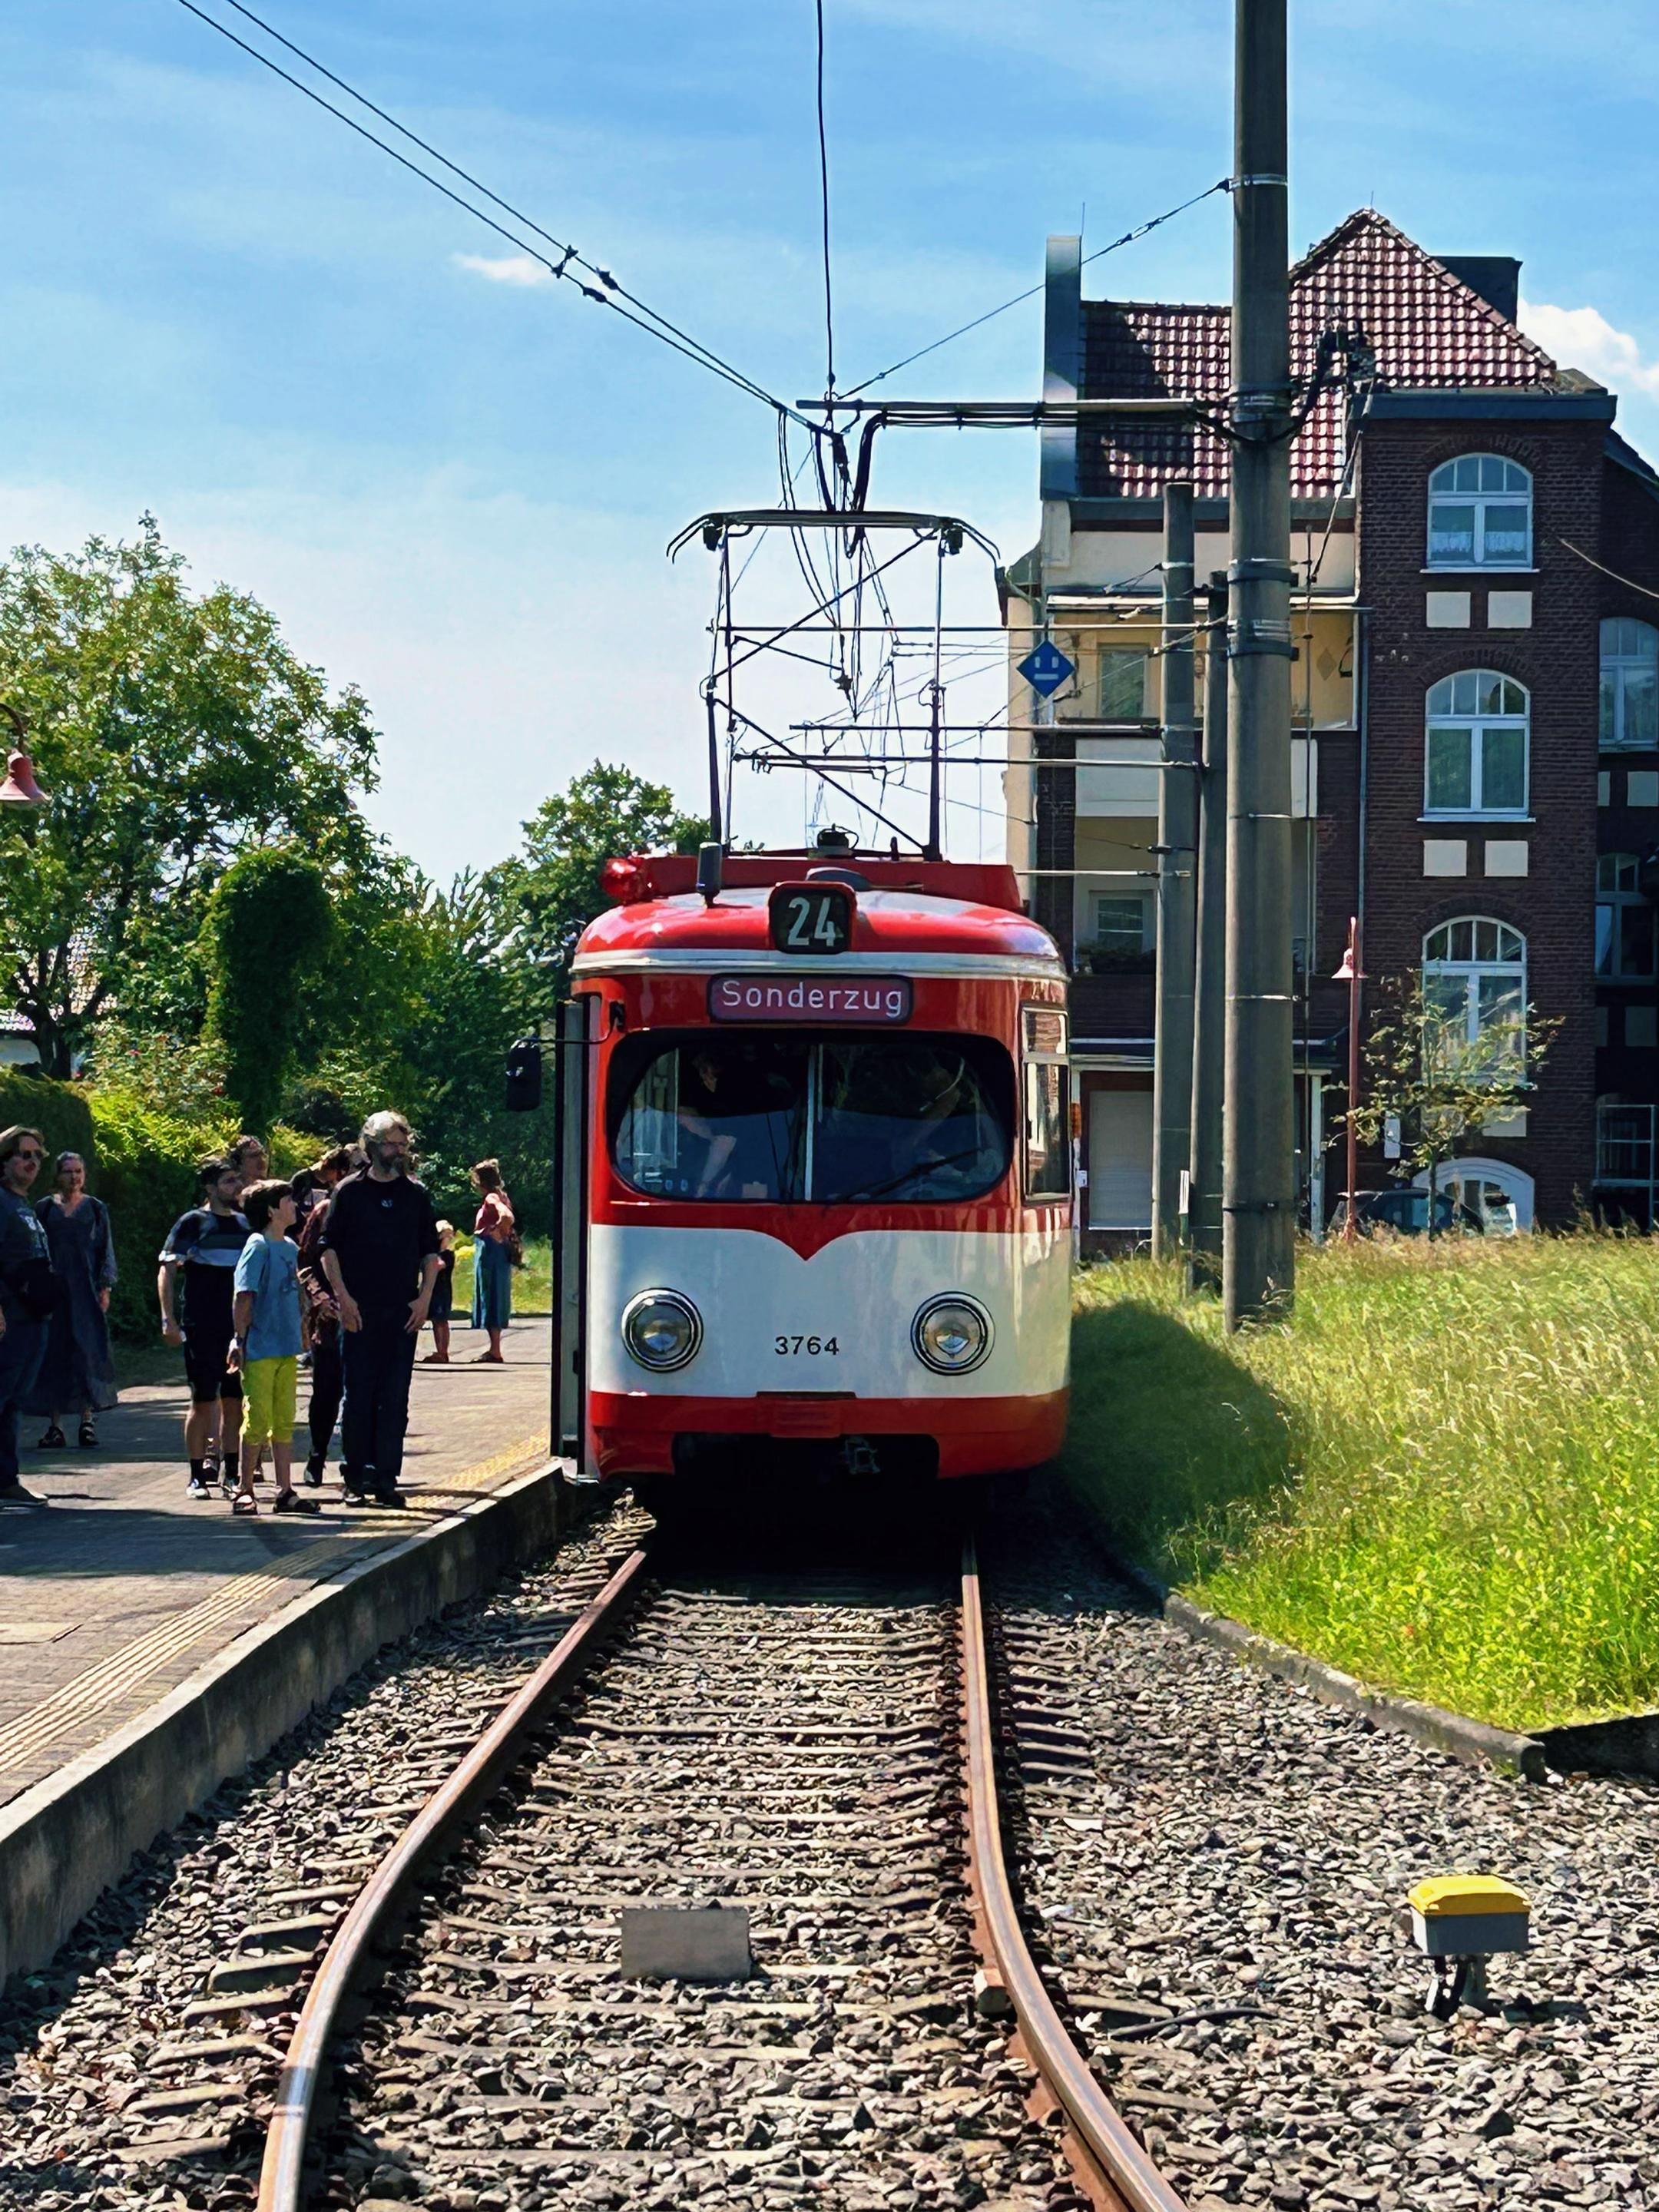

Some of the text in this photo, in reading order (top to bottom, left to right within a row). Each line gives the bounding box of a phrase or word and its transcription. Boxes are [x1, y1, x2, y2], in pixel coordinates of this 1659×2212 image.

[787, 896, 836, 947] 24
[722, 979, 902, 1018] Sonderzug
[774, 1336, 839, 1356] 3764
